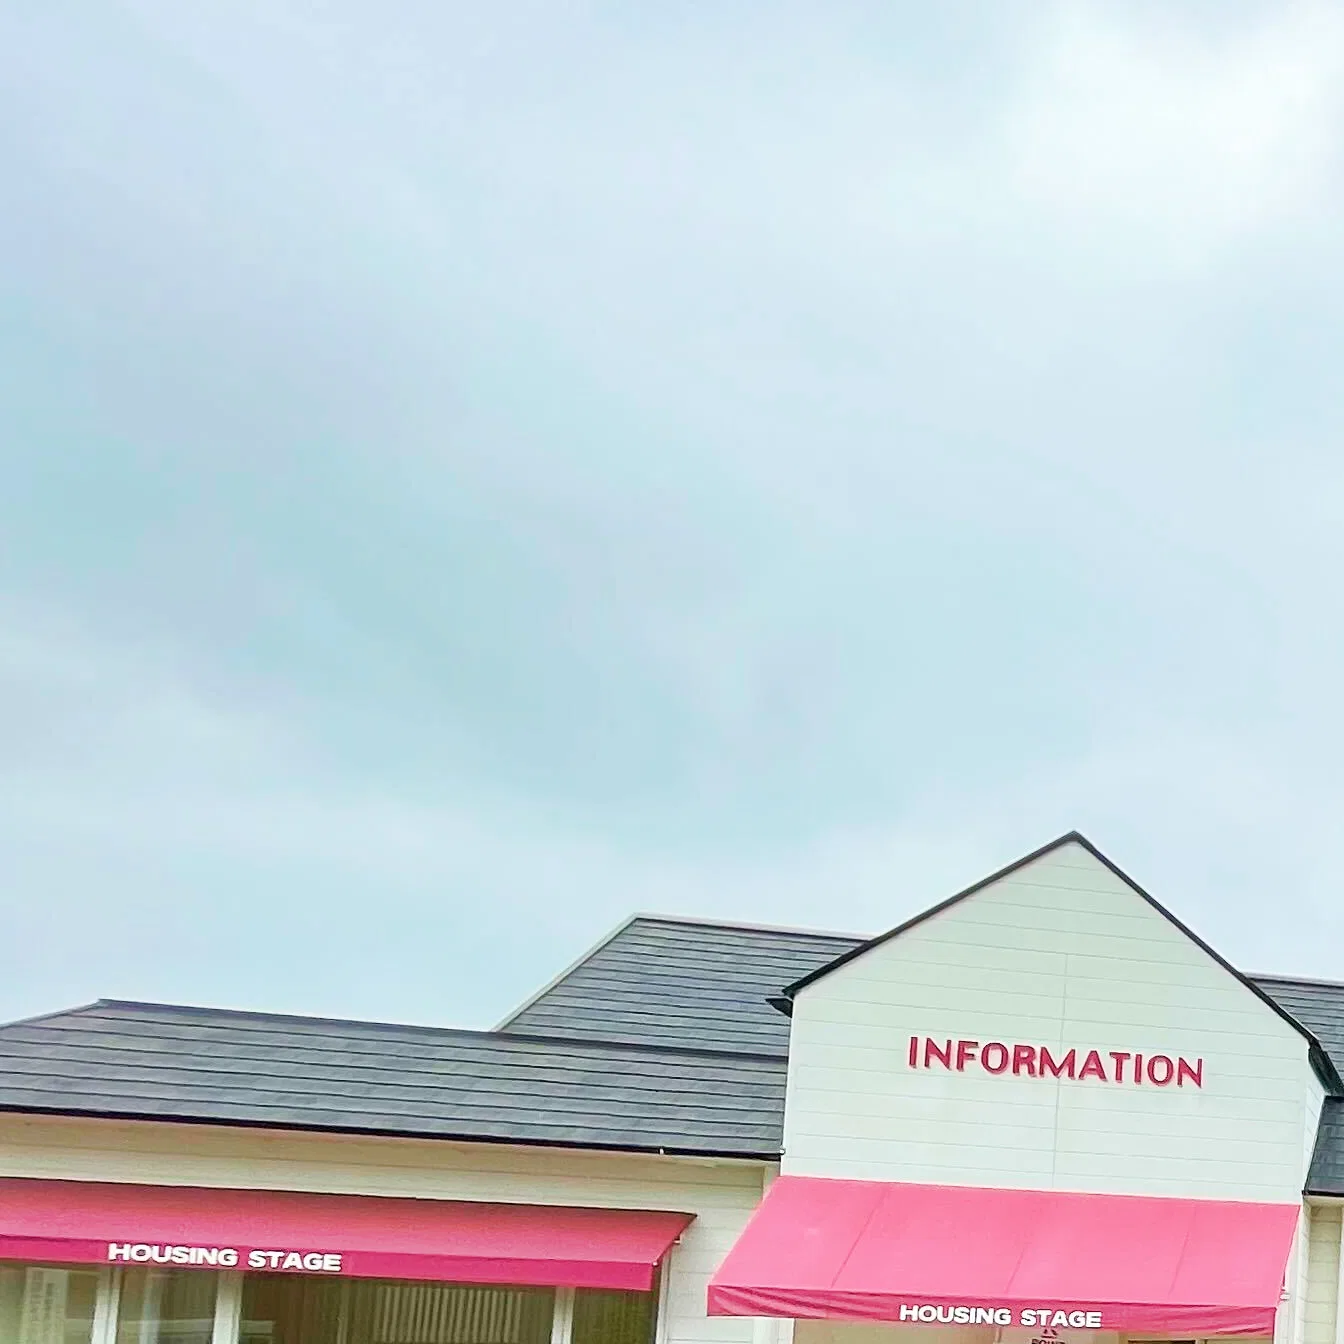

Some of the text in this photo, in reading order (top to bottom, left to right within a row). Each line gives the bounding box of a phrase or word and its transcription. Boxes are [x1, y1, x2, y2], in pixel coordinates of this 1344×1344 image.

[908, 1036, 1204, 1089] INFORMATION
[107, 1242, 343, 1272] HOUSING STAGE
[900, 1304, 1103, 1328] HOUSING STAGE
